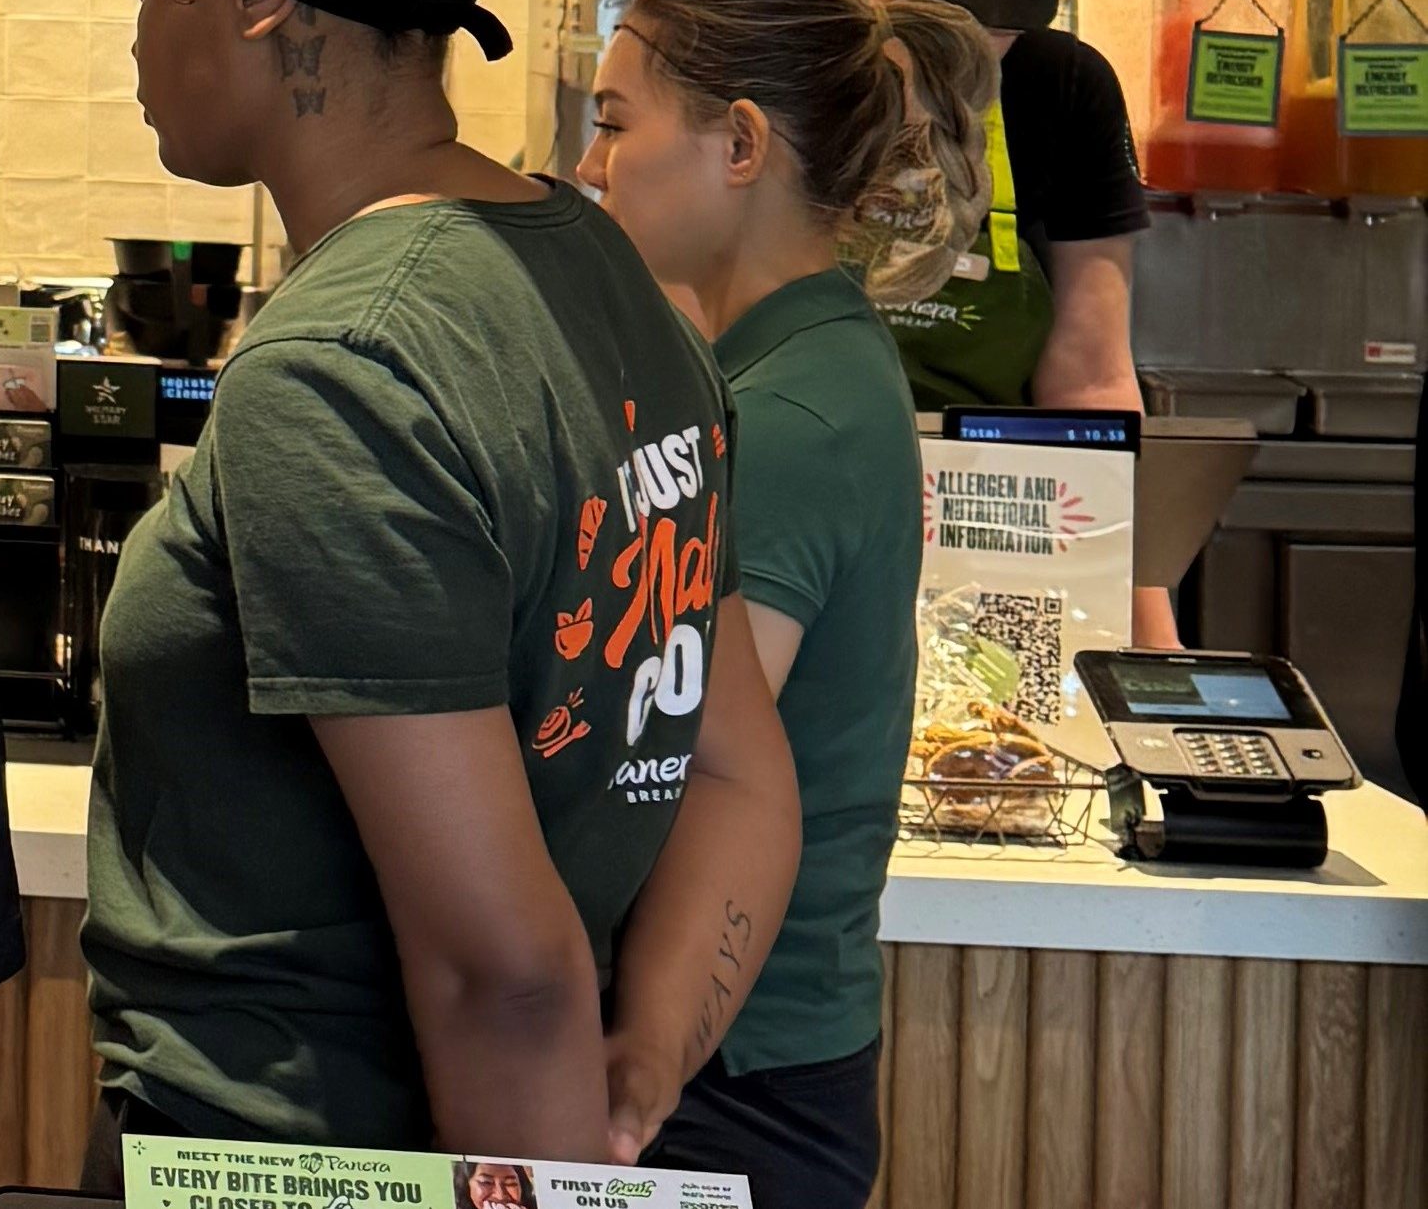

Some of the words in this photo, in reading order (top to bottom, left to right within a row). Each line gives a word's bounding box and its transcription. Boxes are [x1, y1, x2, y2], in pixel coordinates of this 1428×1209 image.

[960, 427, 1001, 439] Total
[632, 425, 704, 518] JUST
[936, 470, 1018, 499] ALLERGEN
[1022, 475, 1057, 501] AND
[942, 498, 1051, 529] NUTRITIONAL
[79, 537, 119, 554] THAN
[939, 524, 1054, 555] INFORMATION
[607, 753, 692, 790] aner
[626, 789, 683, 804] BREA
[177, 1150, 223, 1163] MEET
[225, 1152, 256, 1165] THE
[258, 1155, 296, 1168] NEW
[324, 1156, 392, 1174] Panera
[149, 1166, 223, 1192] EVERY
[226, 1169, 279, 1195] BITE
[282, 1172, 371, 1201] BRINGS
[374, 1180, 423, 1204] YOU
[550, 1178, 603, 1194] FIRST
[189, 1196, 277, 1209] CLOSER
[576, 1196, 609, 1209] ON
[611, 1197, 630, 1209] US
